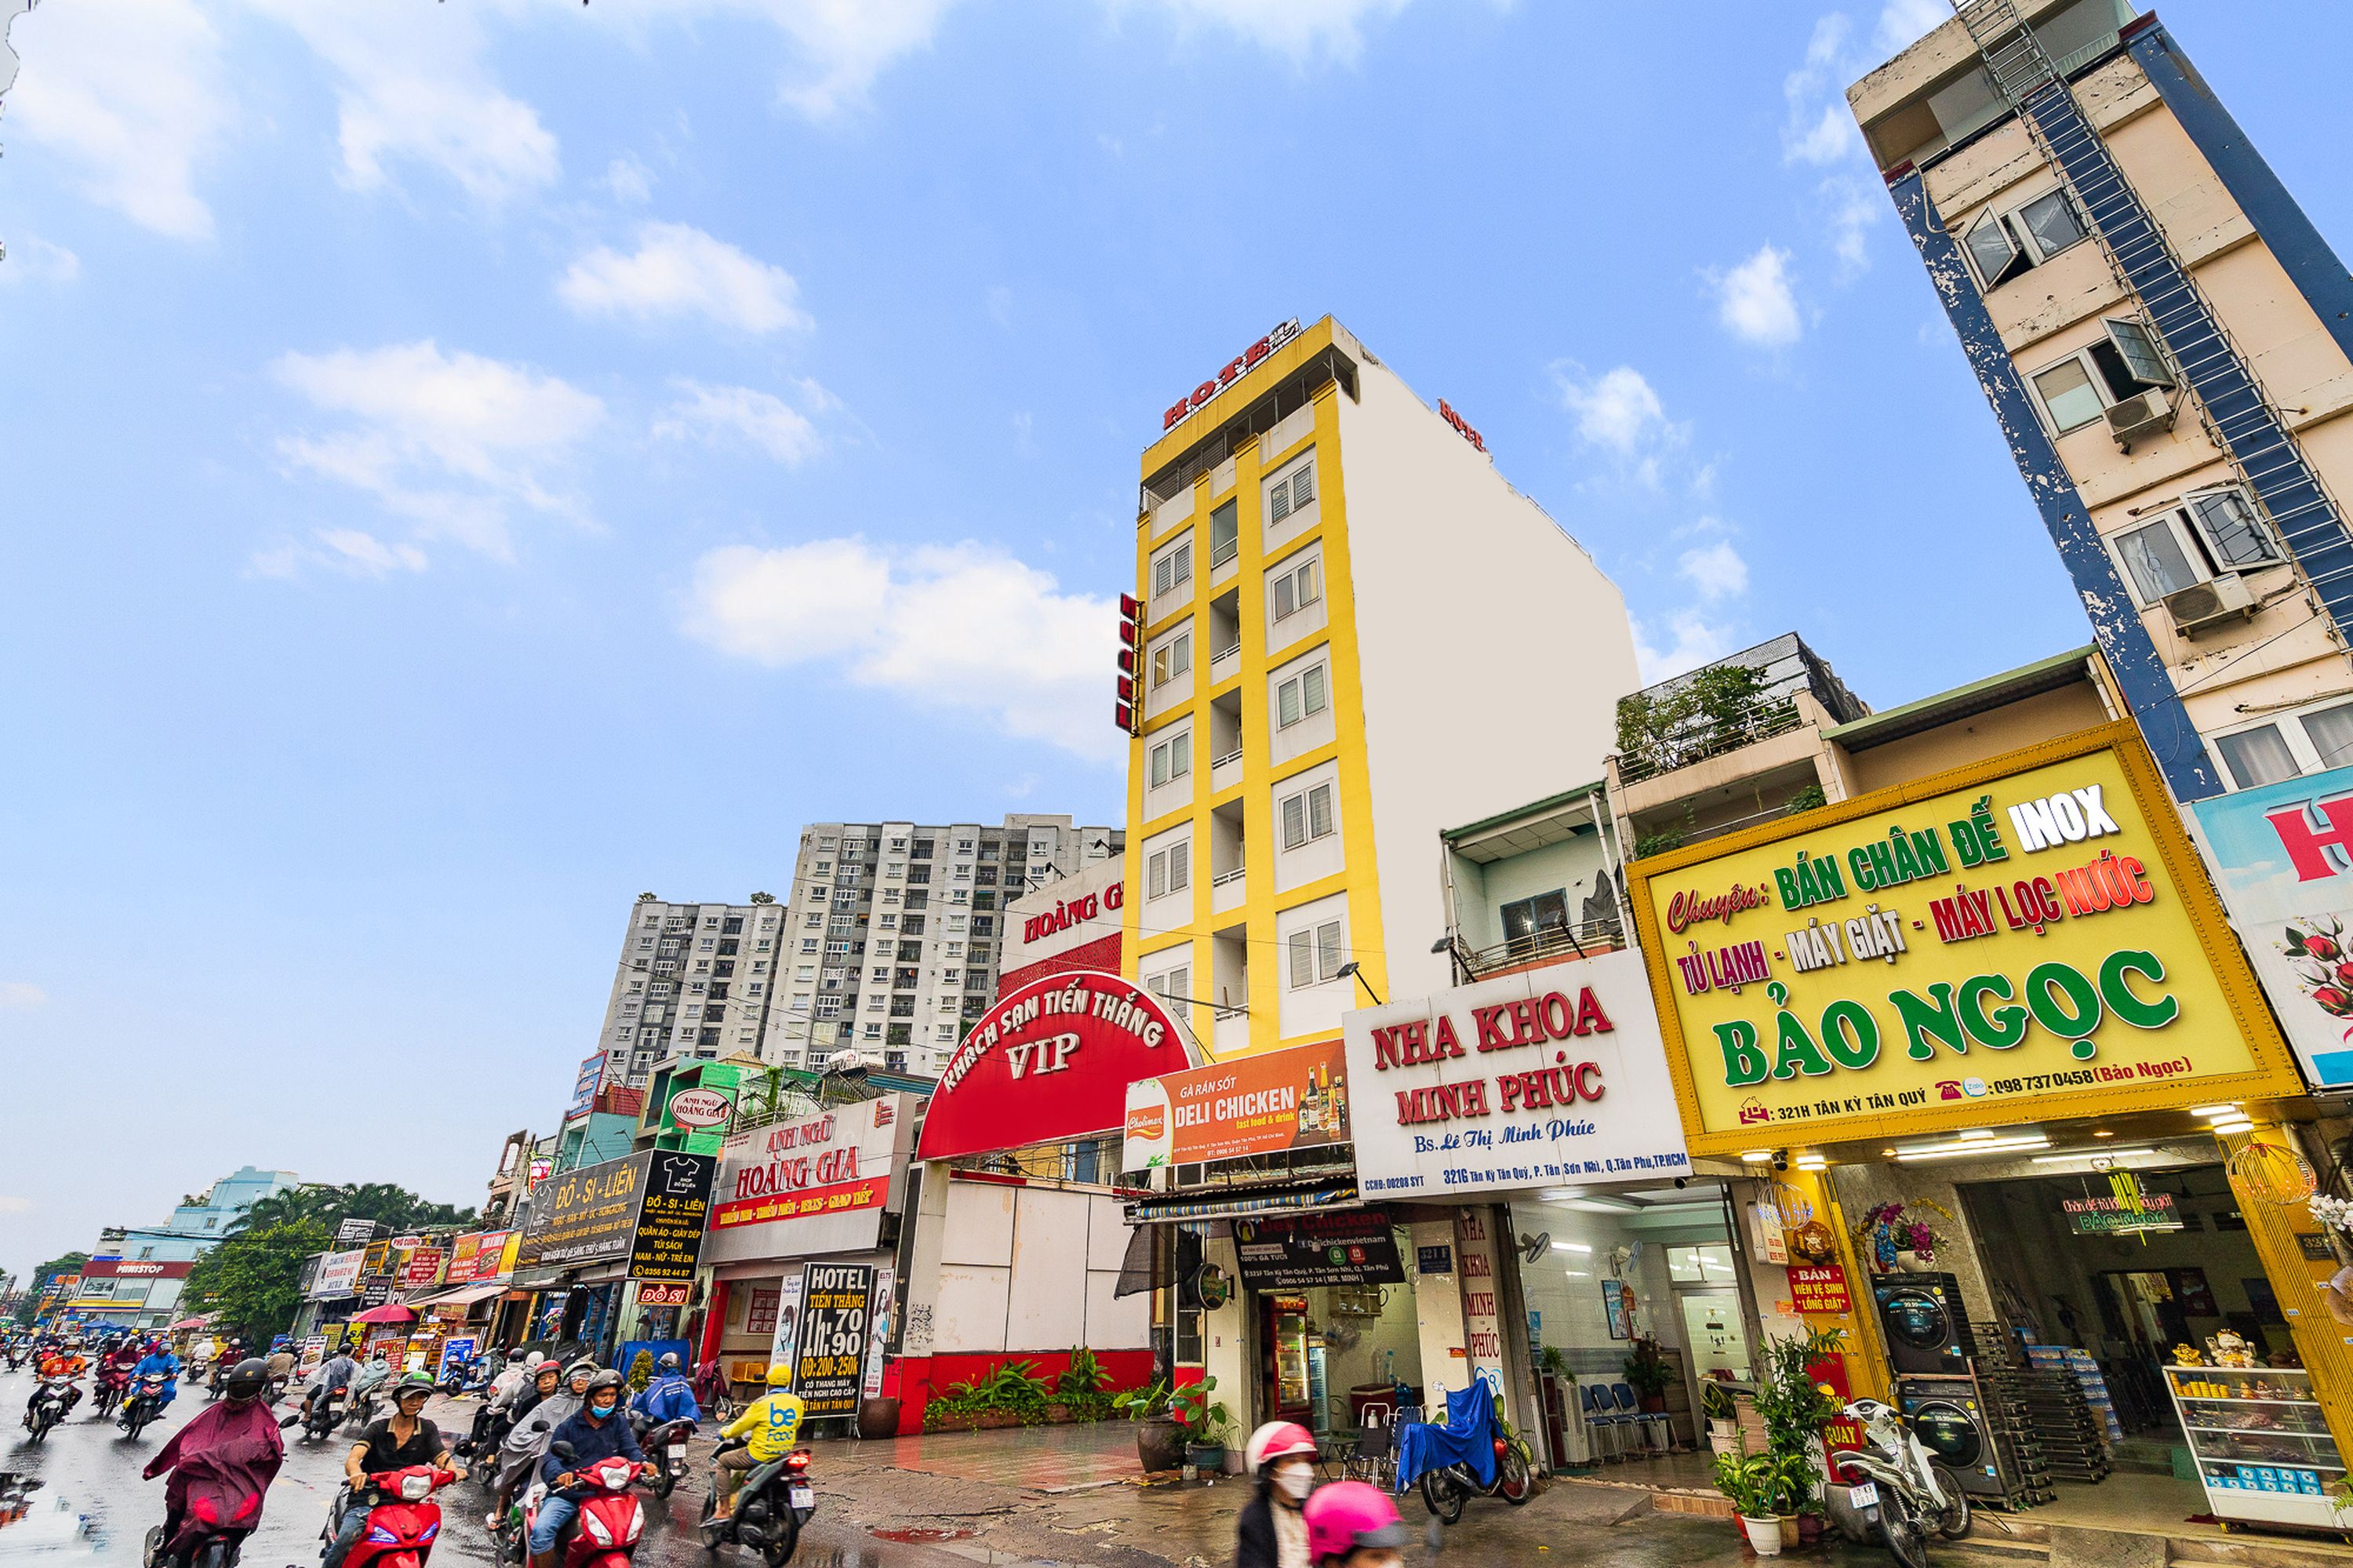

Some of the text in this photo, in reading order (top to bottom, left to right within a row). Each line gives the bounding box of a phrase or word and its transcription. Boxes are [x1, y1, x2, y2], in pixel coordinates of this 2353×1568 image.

[1115, 592, 1137, 734] HOTEL
[1773, 783, 2122, 911] BÁN CHÂN ĐẾ INOX
[1023, 880, 1125, 944] HOÀNG G
[1666, 882, 1769, 935] Chuyên:
[1676, 848, 2155, 995] TỦ LẠNH MÁY GIẶT MÁY LỌC NƯỚC
[1371, 985, 1614, 1071] NHA KHOA
[1711, 949, 2180, 1088] BẢO NGỌC
[943, 977, 1165, 1094] KHÁCH SẠN TIẾN THẮNG
[1005, 1031, 1081, 1080] VIP
[1180, 1074, 1238, 1098] GÀ RÁN SỐT
[1395, 1050, 1606, 1126] MINH PHÚC
[1175, 1086, 1294, 1130] DELI CHICKEN
[1813, 1100, 1842, 1116] TÂN
[1845, 1095, 1863, 1112] KỲ
[1865, 1093, 1895, 1109] TÂN
[1900, 1087, 1926, 1106] QUÝ
[1235, 1119, 1249, 1130] fast
[1250, 1115, 1267, 1128] food
[1275, 1111, 1296, 1124] drink
[765, 1127, 799, 1155] ANH
[799, 1113, 837, 1148] NGỮ
[1463, 1129, 1493, 1151] Thị
[1498, 1122, 1544, 1144] Minh
[1545, 1119, 1596, 1141] Phúc
[734, 1144, 863, 1200] HOÀNG GIA
[1409, 1176, 1424, 1188] SYT
[1443, 1168, 1469, 1185] 321G
[1469, 1170, 1484, 1182] Tân
[1485, 1169, 1496, 1183] Kỳ
[1497, 1168, 1511, 1181] Tân
[1533, 1165, 1544, 1177] P.
[1544, 1163, 1561, 1176] Tân
[1563, 1162, 1582, 1175] Sơn
[555, 1163, 638, 1210] ĐỒ SI LIÊN
[827, 1192, 852, 1209] GIAO
[852, 1183, 874, 1206] TIẾP
[646, 1194, 705, 1211] ĐỒ SI LIÊN
[638, 1224, 659, 1238] QUẦN
[658, 1226, 669, 1238] ÁO
[672, 1227, 688, 1238] GIÀY
[687, 1228, 701, 1239] DÉP
[653, 1239, 683, 1250] TÚI SÁCH
[116, 1264, 164, 1274] MINISTOP
[635, 1252, 652, 1261] NAM
[671, 1251, 684, 1263] TRẺ
[683, 1254, 694, 1264] EM
[644, 1267, 690, 1277] 0356 92 44 87
[811, 1268, 867, 1290] HOTEL
[1798, 1267, 1832, 1281] BÁN
[641, 1285, 686, 1303] ĐỒ SI
[809, 1287, 865, 1308] TIẾN THẮNG
[1460, 1218, 1500, 1358] NHA KHOA MINH PHÚC
[1794, 1281, 1845, 1297] VIÊN VỆ SINH
[1824, 1295, 1842, 1312] GIẶT
[835, 1308, 863, 1332] 70
[831, 1332, 861, 1356] 90
[837, 1379, 851, 1388] MÁY
[842, 1385, 856, 1396] CẤP
[769, 1402, 797, 1428] be
[1824, 1425, 1857, 1446] QUAY
